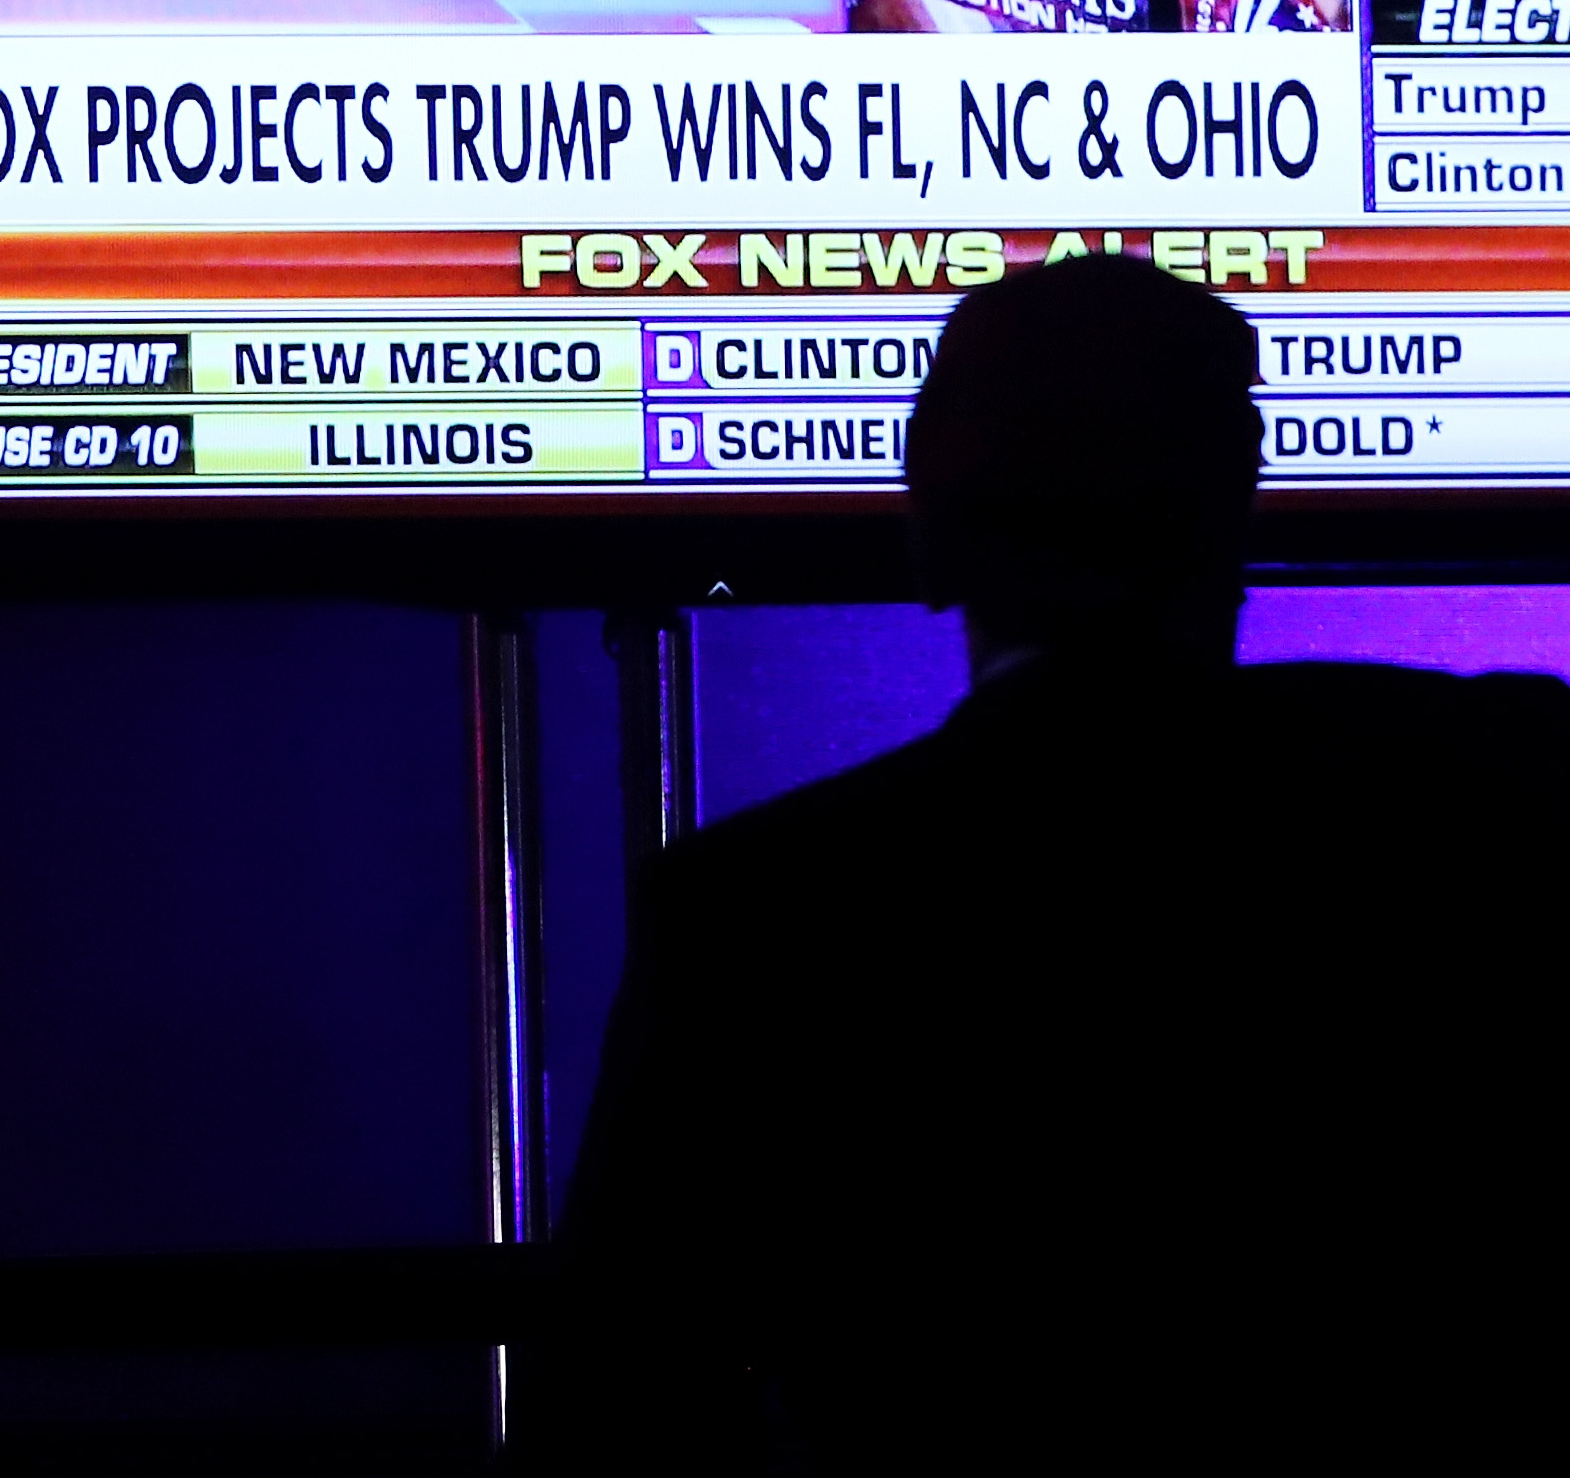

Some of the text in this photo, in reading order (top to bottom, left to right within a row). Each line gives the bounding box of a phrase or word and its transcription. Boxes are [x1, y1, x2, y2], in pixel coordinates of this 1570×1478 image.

[1383, 75, 1548, 126] Trump
[87, 82, 394, 185] PROJECTS
[416, 80, 632, 183] TRUMP
[653, 80, 830, 182] WINS
[858, 82, 934, 199] FL,
[961, 80, 1051, 181] NC
[1077, 79, 1125, 181] &
[1145, 78, 1319, 180] OHIO
[1387, 152, 1565, 193] Clinton
[520, 233, 709, 289] FOX
[739, 230, 1007, 287] NEWS
[234, 340, 602, 386] NEW MEXICO
[656, 334, 694, 382] D
[1270, 334, 1463, 376] TRUMP
[63, 425, 118, 468] CD
[131, 425, 180, 468] 10
[309, 423, 534, 467] ILLINOIS
[658, 415, 901, 463] D SCHNEI
